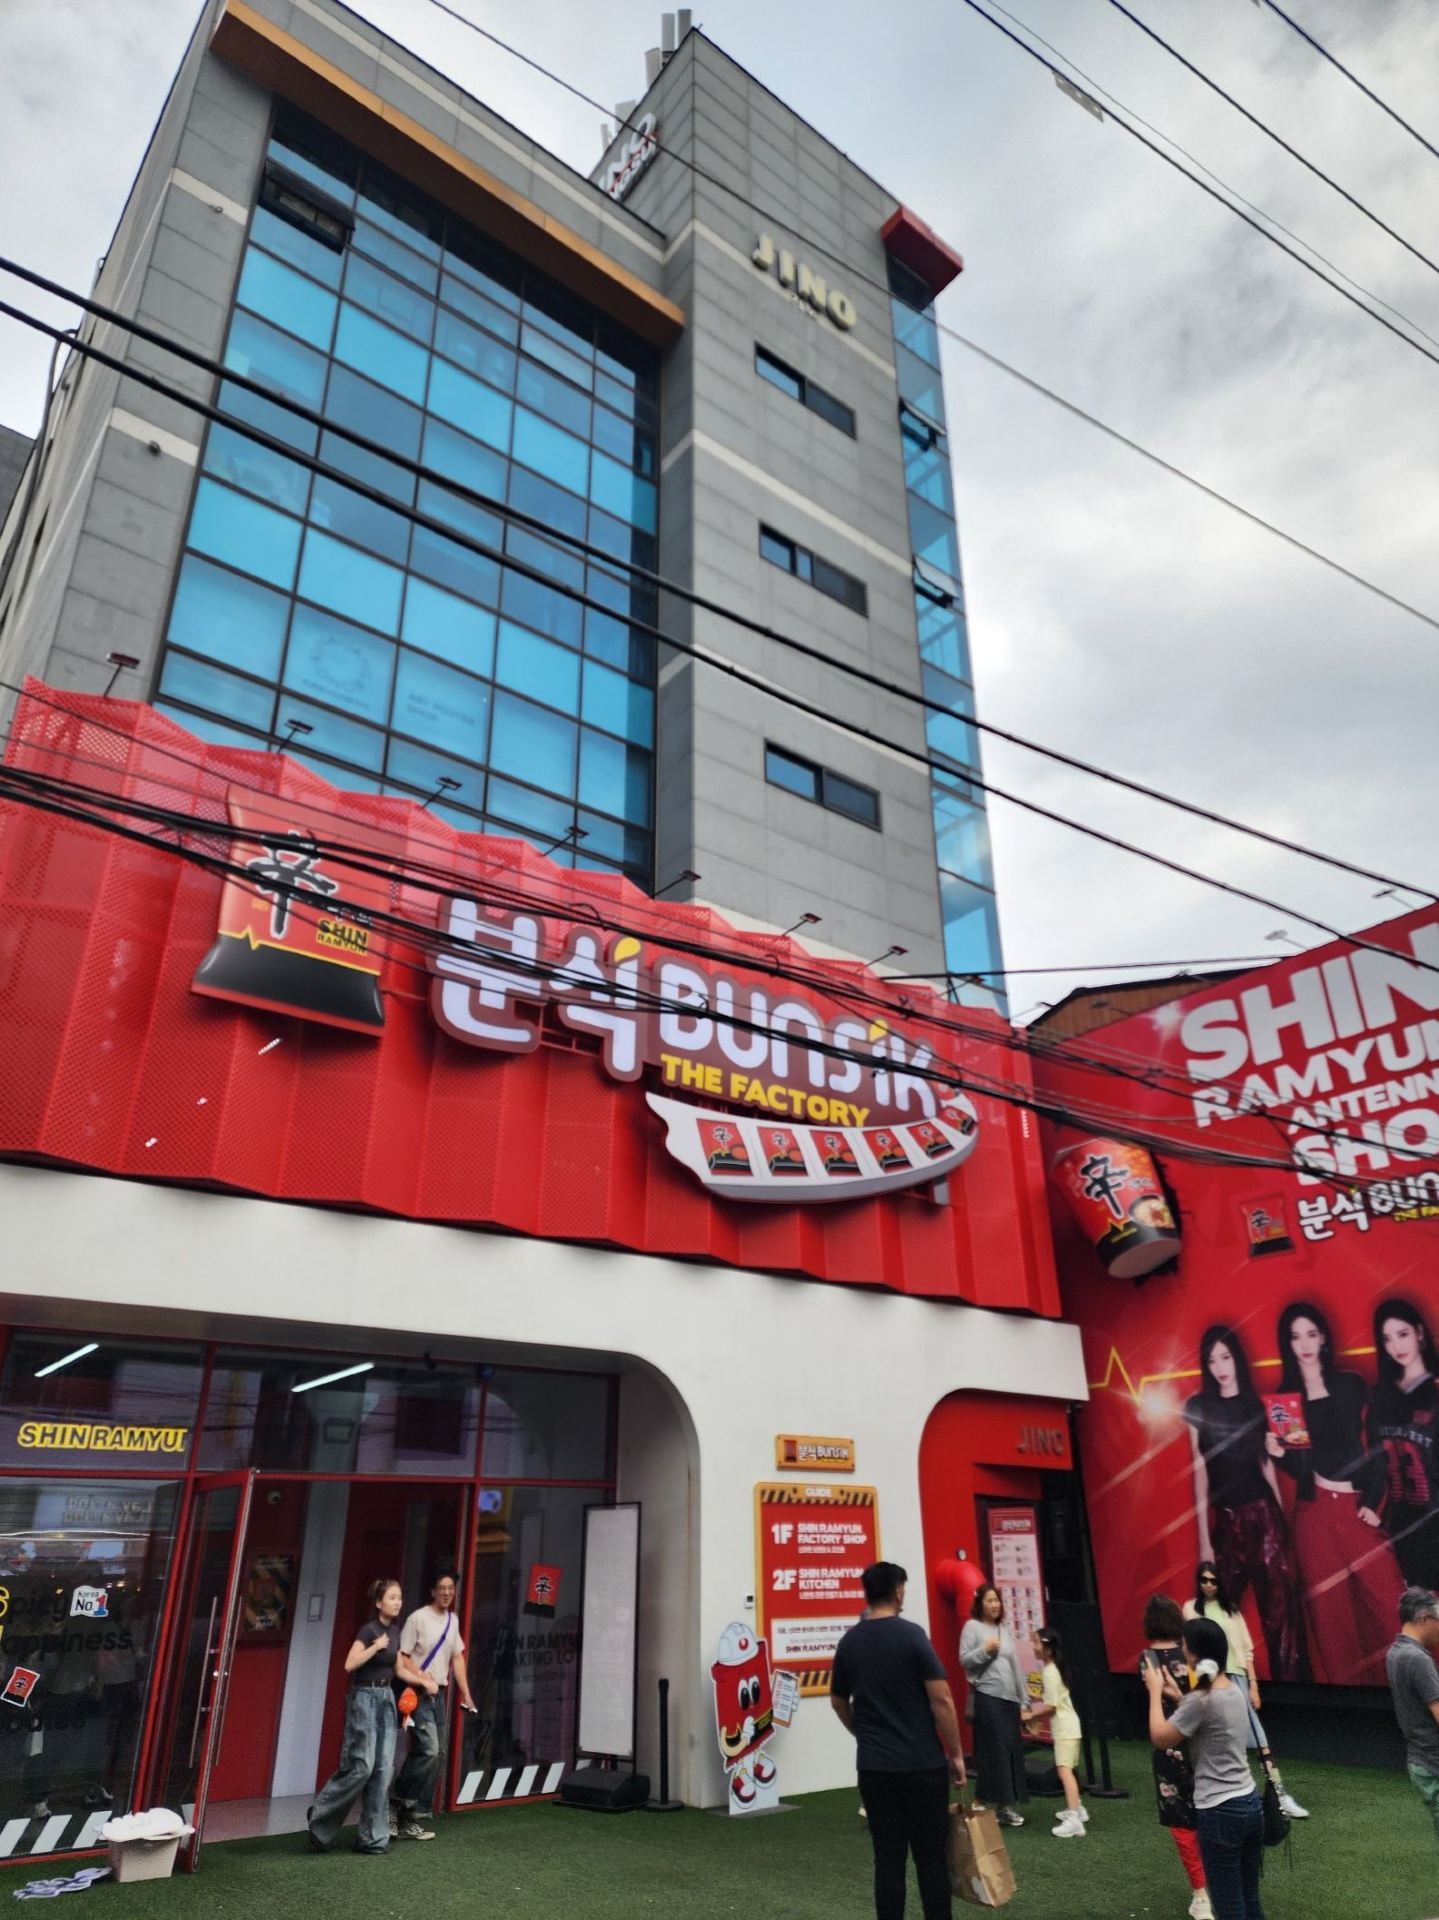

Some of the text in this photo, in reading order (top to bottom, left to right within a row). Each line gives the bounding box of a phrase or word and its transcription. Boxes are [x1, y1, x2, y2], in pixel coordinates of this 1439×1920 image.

[752, 233, 857, 328] JINO
[246, 829, 339, 940] 辛
[318, 919, 368, 946] SHIN
[435, 897, 641, 1073] 분식
[1181, 922, 1439, 1082] SHIN
[660, 1053, 871, 1128] THE FACTORY
[1079, 1153, 1130, 1219] 辛
[1297, 1186, 1370, 1241] 분식
[17, 1421, 90, 1449] SHIN
[771, 1523, 863, 1544] 1F SHIN RAMYUN
[798, 1534, 867, 1544] FACTORY SHOP
[773, 1569, 797, 1590] 2F
[799, 1568, 819, 1578] SHIN
[799, 1579, 839, 1589] KITCHEN
[75, 1594, 109, 1616] No 1
[0, 1624, 133, 1662] appiness
